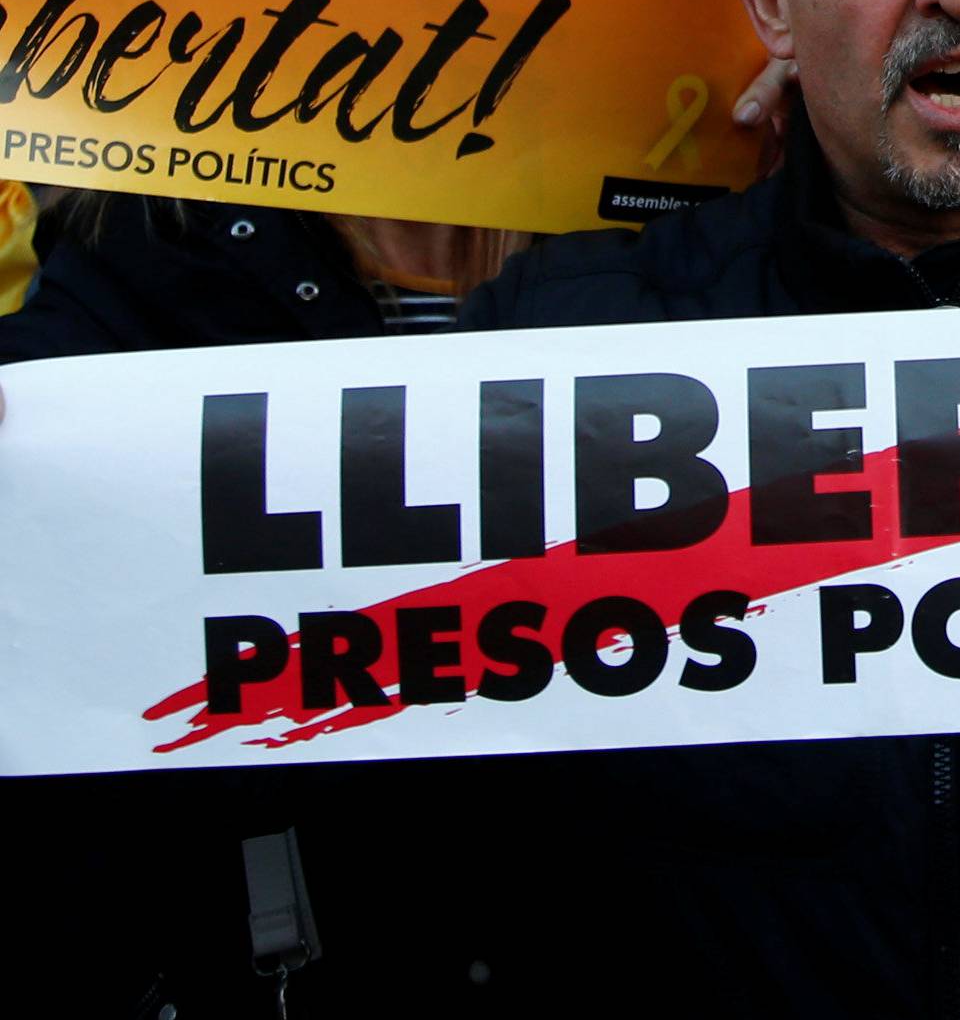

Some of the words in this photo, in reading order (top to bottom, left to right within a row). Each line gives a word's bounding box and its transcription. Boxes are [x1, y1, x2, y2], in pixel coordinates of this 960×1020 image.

[4, 128, 156, 175] PRESOS
[168, 147, 337, 194] POLÍTICS
[203, 589, 758, 715] PRESOS
